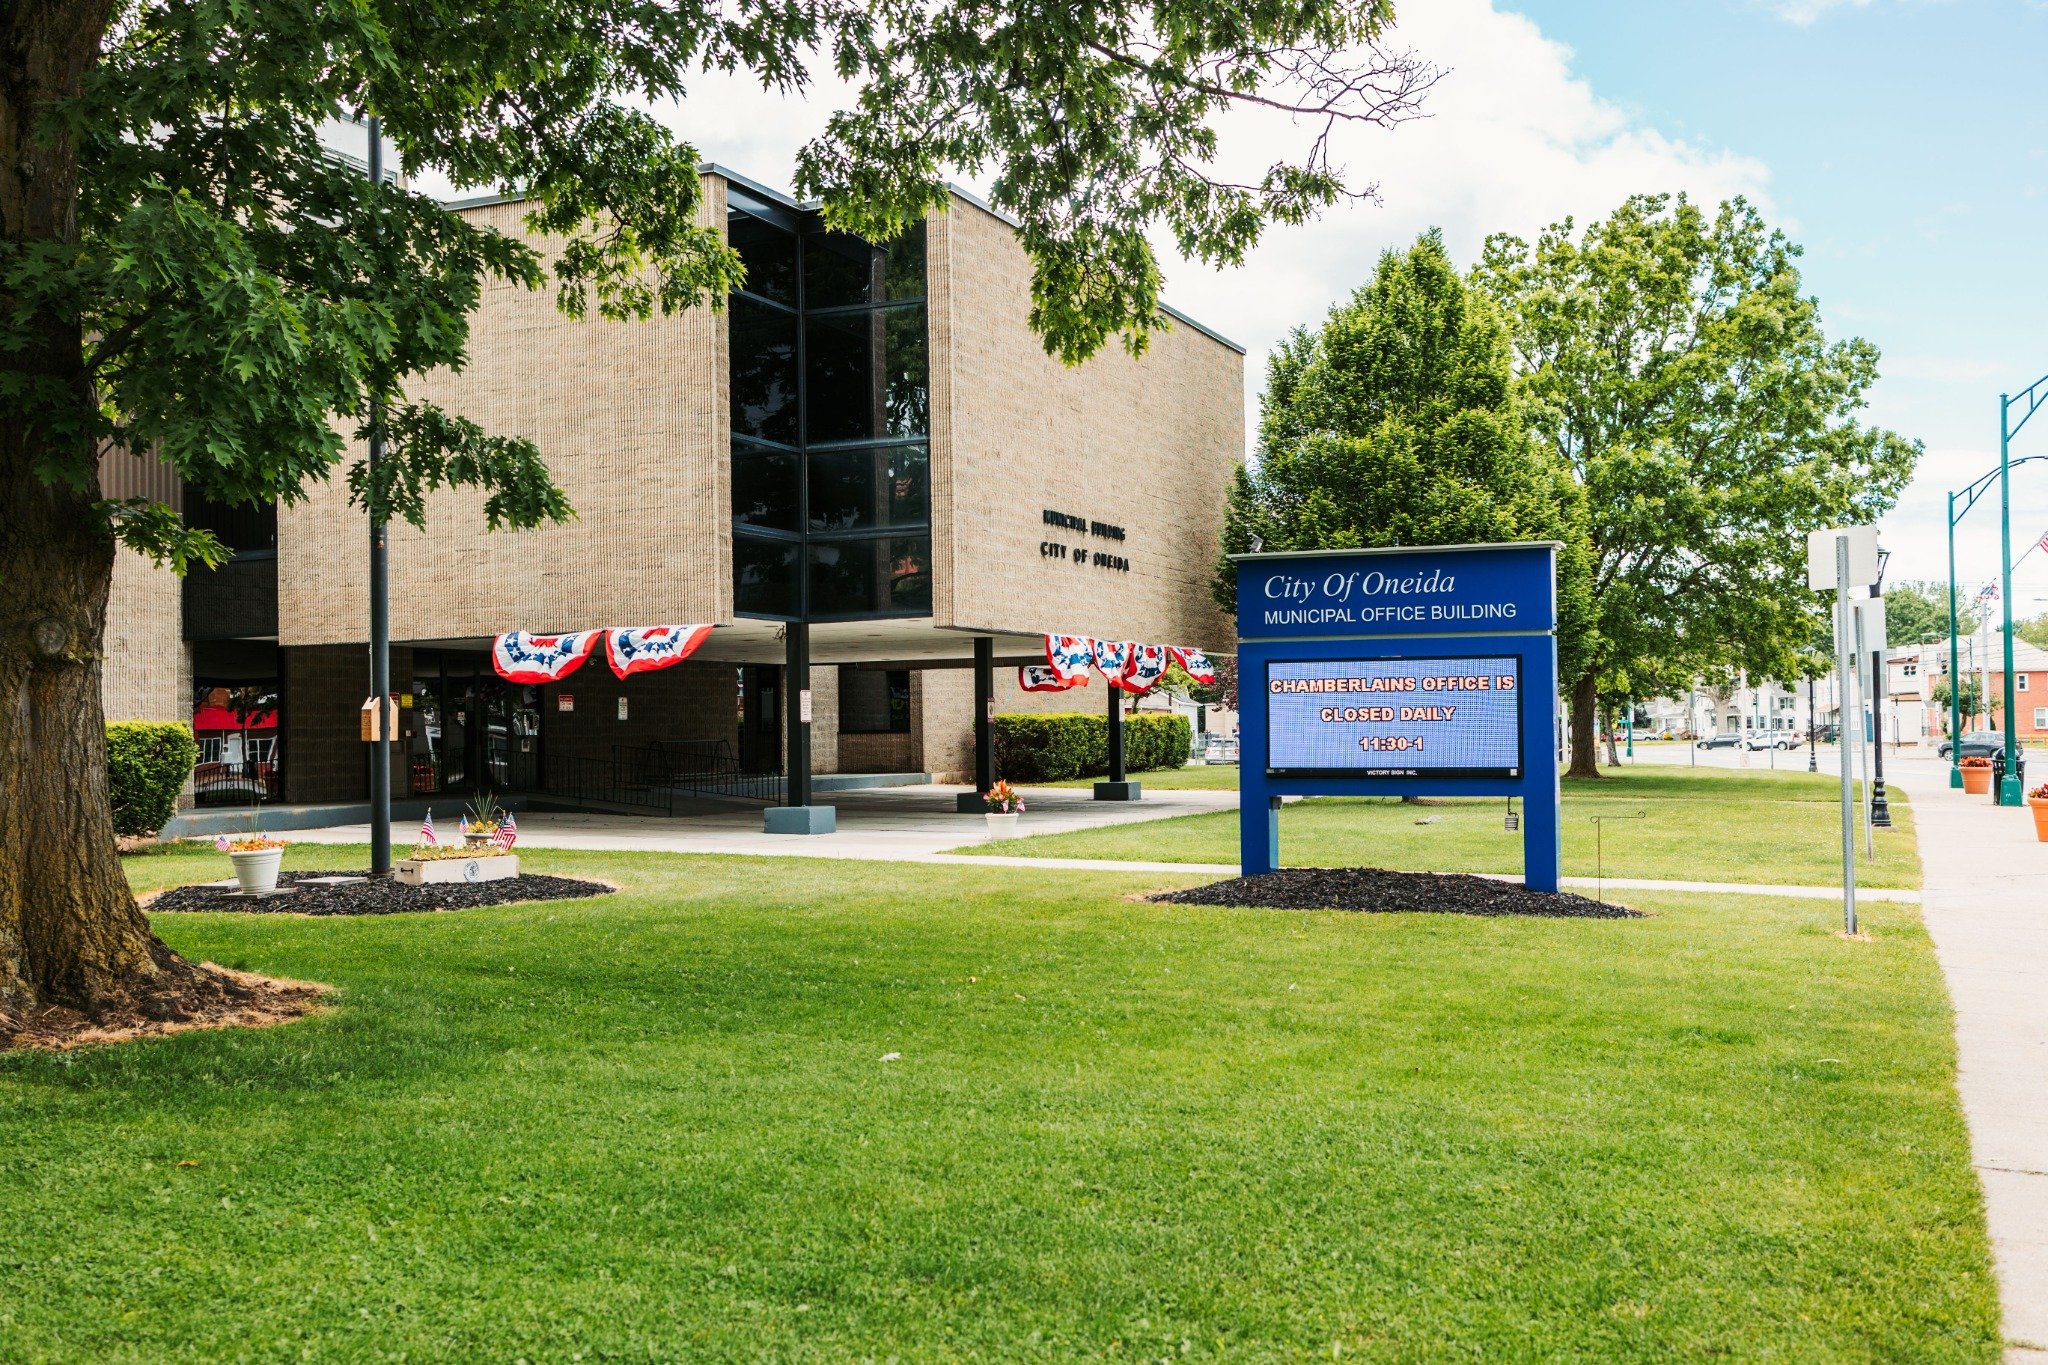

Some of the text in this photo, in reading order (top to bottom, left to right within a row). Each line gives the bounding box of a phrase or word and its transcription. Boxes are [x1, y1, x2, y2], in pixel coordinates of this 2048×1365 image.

[1040, 541, 1130, 571] CITY OF ONEIDA
[1264, 569, 1455, 604] City Of Oneida
[1264, 603, 1517, 625] MUNICIPAL OFFICE BUILDING
[1270, 675, 1515, 693] CHAMBERLAINS OFFICE IS
[1321, 706, 1456, 722] CLOSED DAILY
[1359, 736, 1424, 751] 11:30-1
